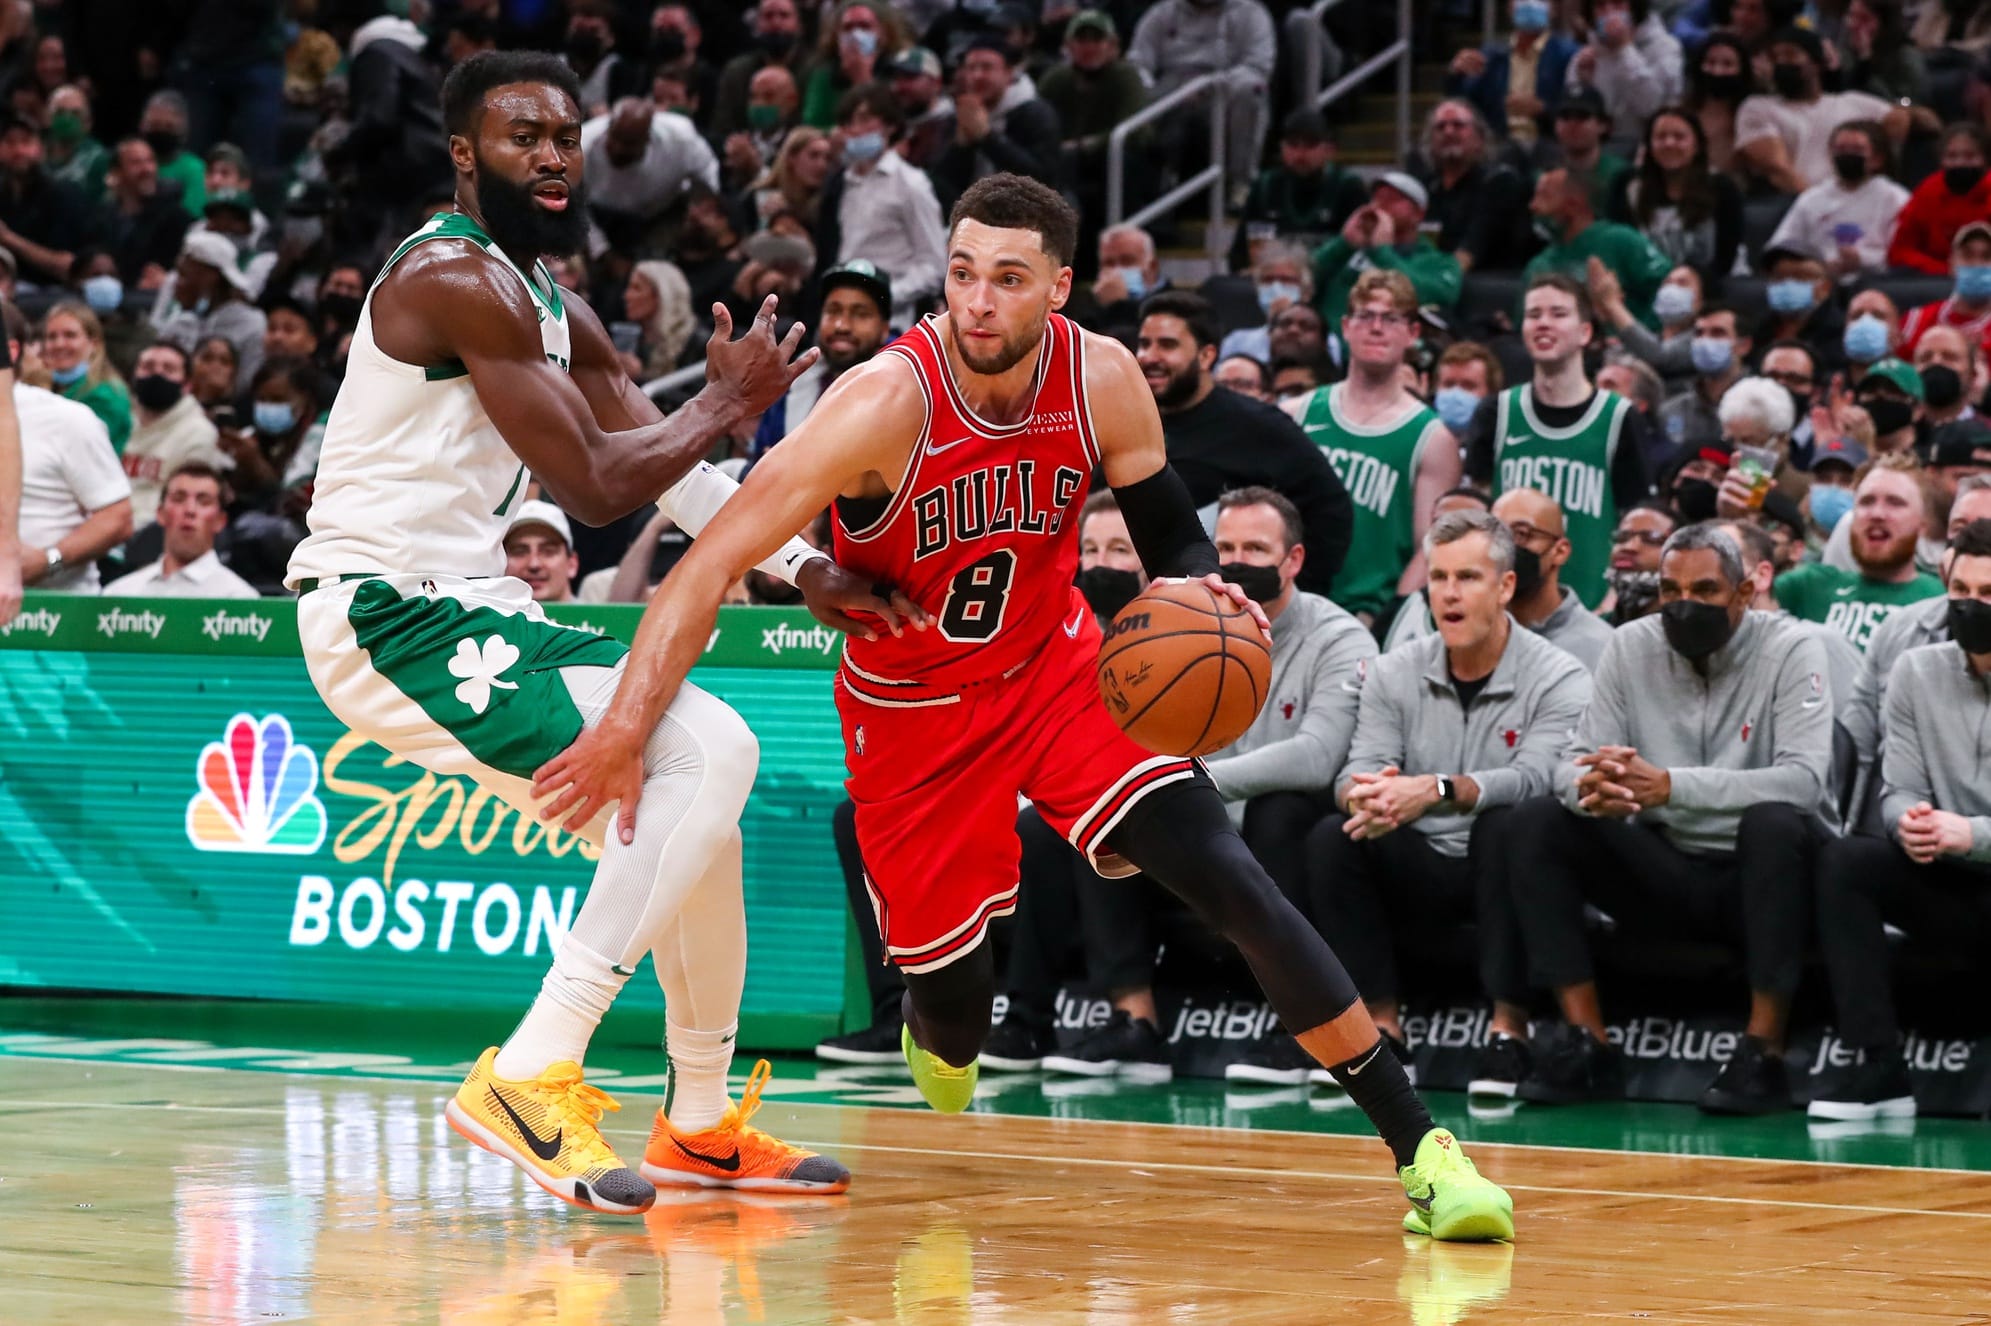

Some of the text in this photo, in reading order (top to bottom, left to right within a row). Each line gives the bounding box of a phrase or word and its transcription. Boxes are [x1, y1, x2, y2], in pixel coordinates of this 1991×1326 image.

[1027, 424, 1074, 435] EYEWEAR
[912, 460, 1084, 563] BULLS
[937, 547, 1018, 643] 8
[98, 607, 166, 638] xfinity
[203, 609, 272, 641] xfinity
[761, 621, 839, 655] xfinity
[289, 875, 577, 959] BOSTON
[1168, 997, 1279, 1044] jetBl
[1605, 1017, 1738, 1062] etBlue
